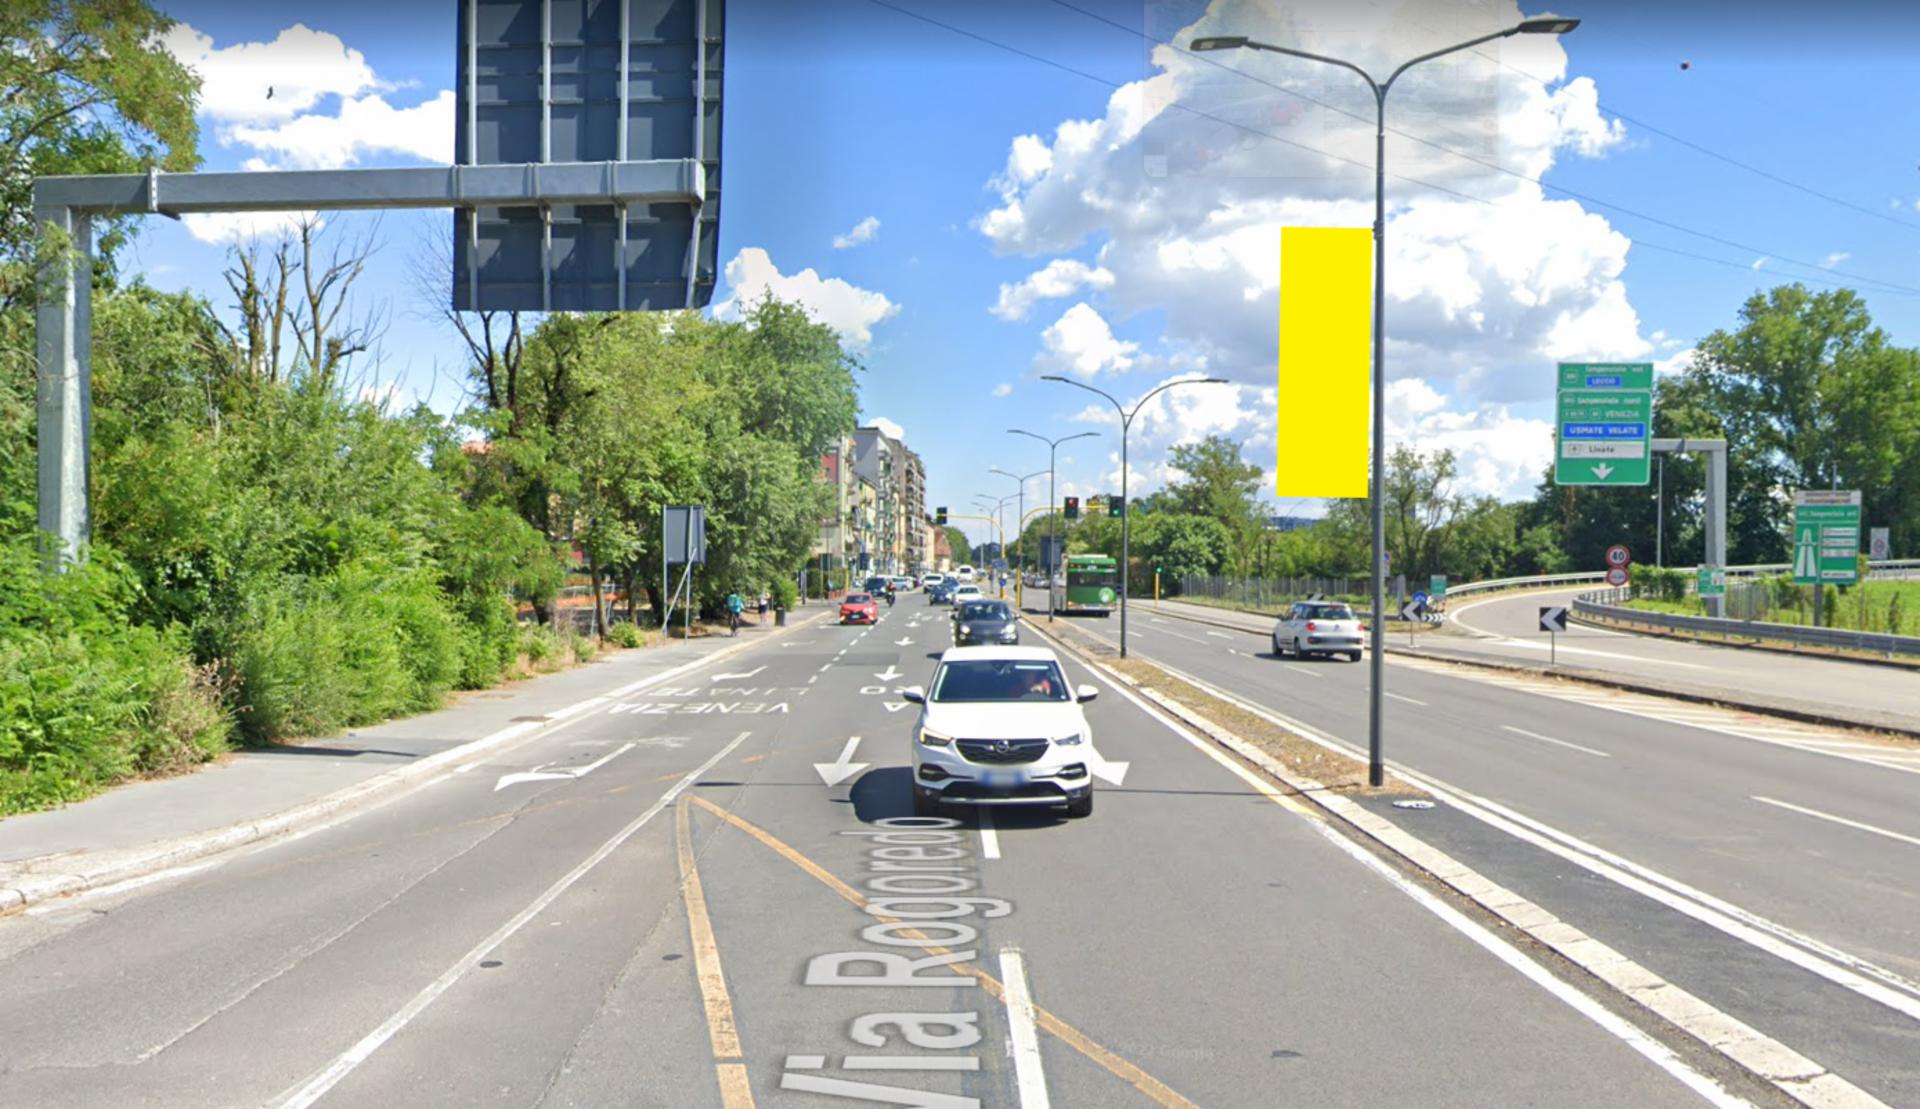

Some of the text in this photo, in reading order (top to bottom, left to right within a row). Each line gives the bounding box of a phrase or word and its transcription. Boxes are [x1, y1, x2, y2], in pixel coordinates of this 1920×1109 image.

[1588, 445, 1615, 453] Linate
[1612, 551, 1625, 561] 40
[608, 702, 790, 714] VENEZIA
